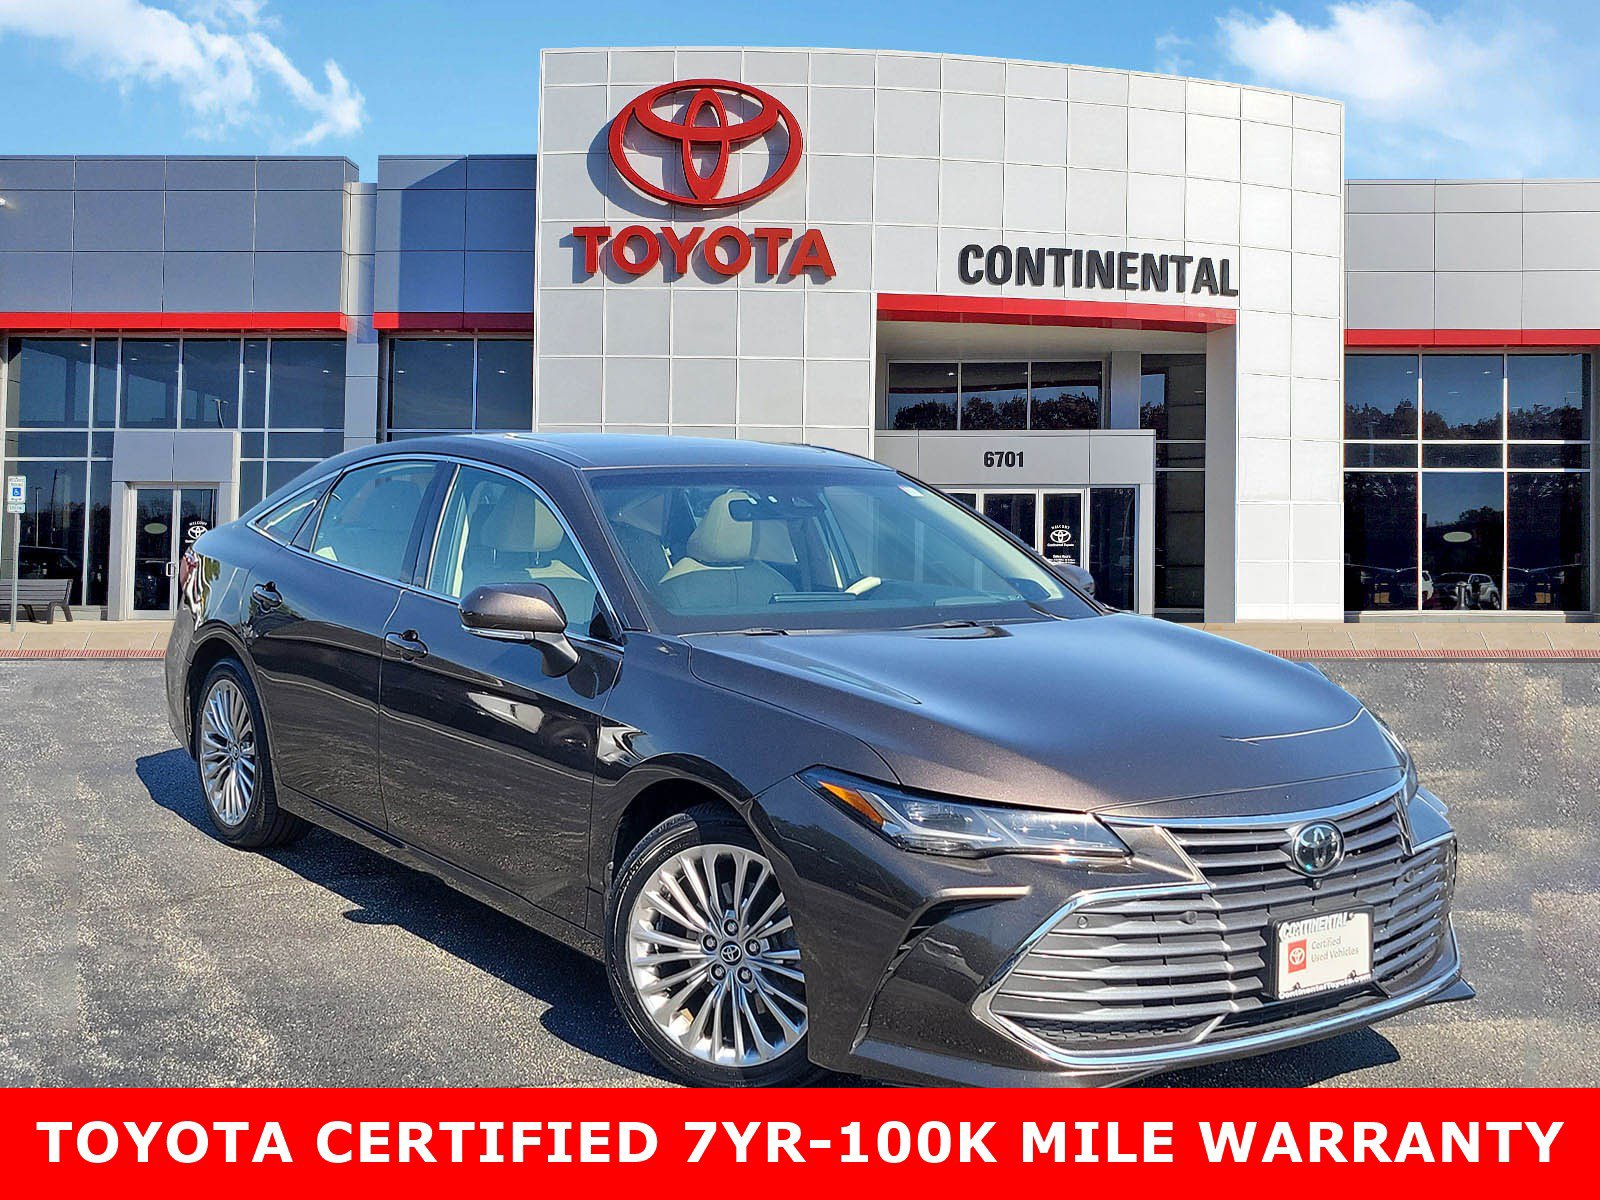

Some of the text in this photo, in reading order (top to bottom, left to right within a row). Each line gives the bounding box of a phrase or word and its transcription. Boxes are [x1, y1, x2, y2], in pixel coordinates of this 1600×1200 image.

[573, 226, 836, 278] TOYOTA
[959, 242, 1239, 298] CONTINENTAL
[983, 451, 1024, 468] 6701
[1279, 912, 1349, 940] CONTINENTAL
[1311, 936, 1342, 950] Certified
[1311, 946, 1360, 963] Used Vehicles
[1278, 973, 1372, 1000] ContinentalToyota.com
